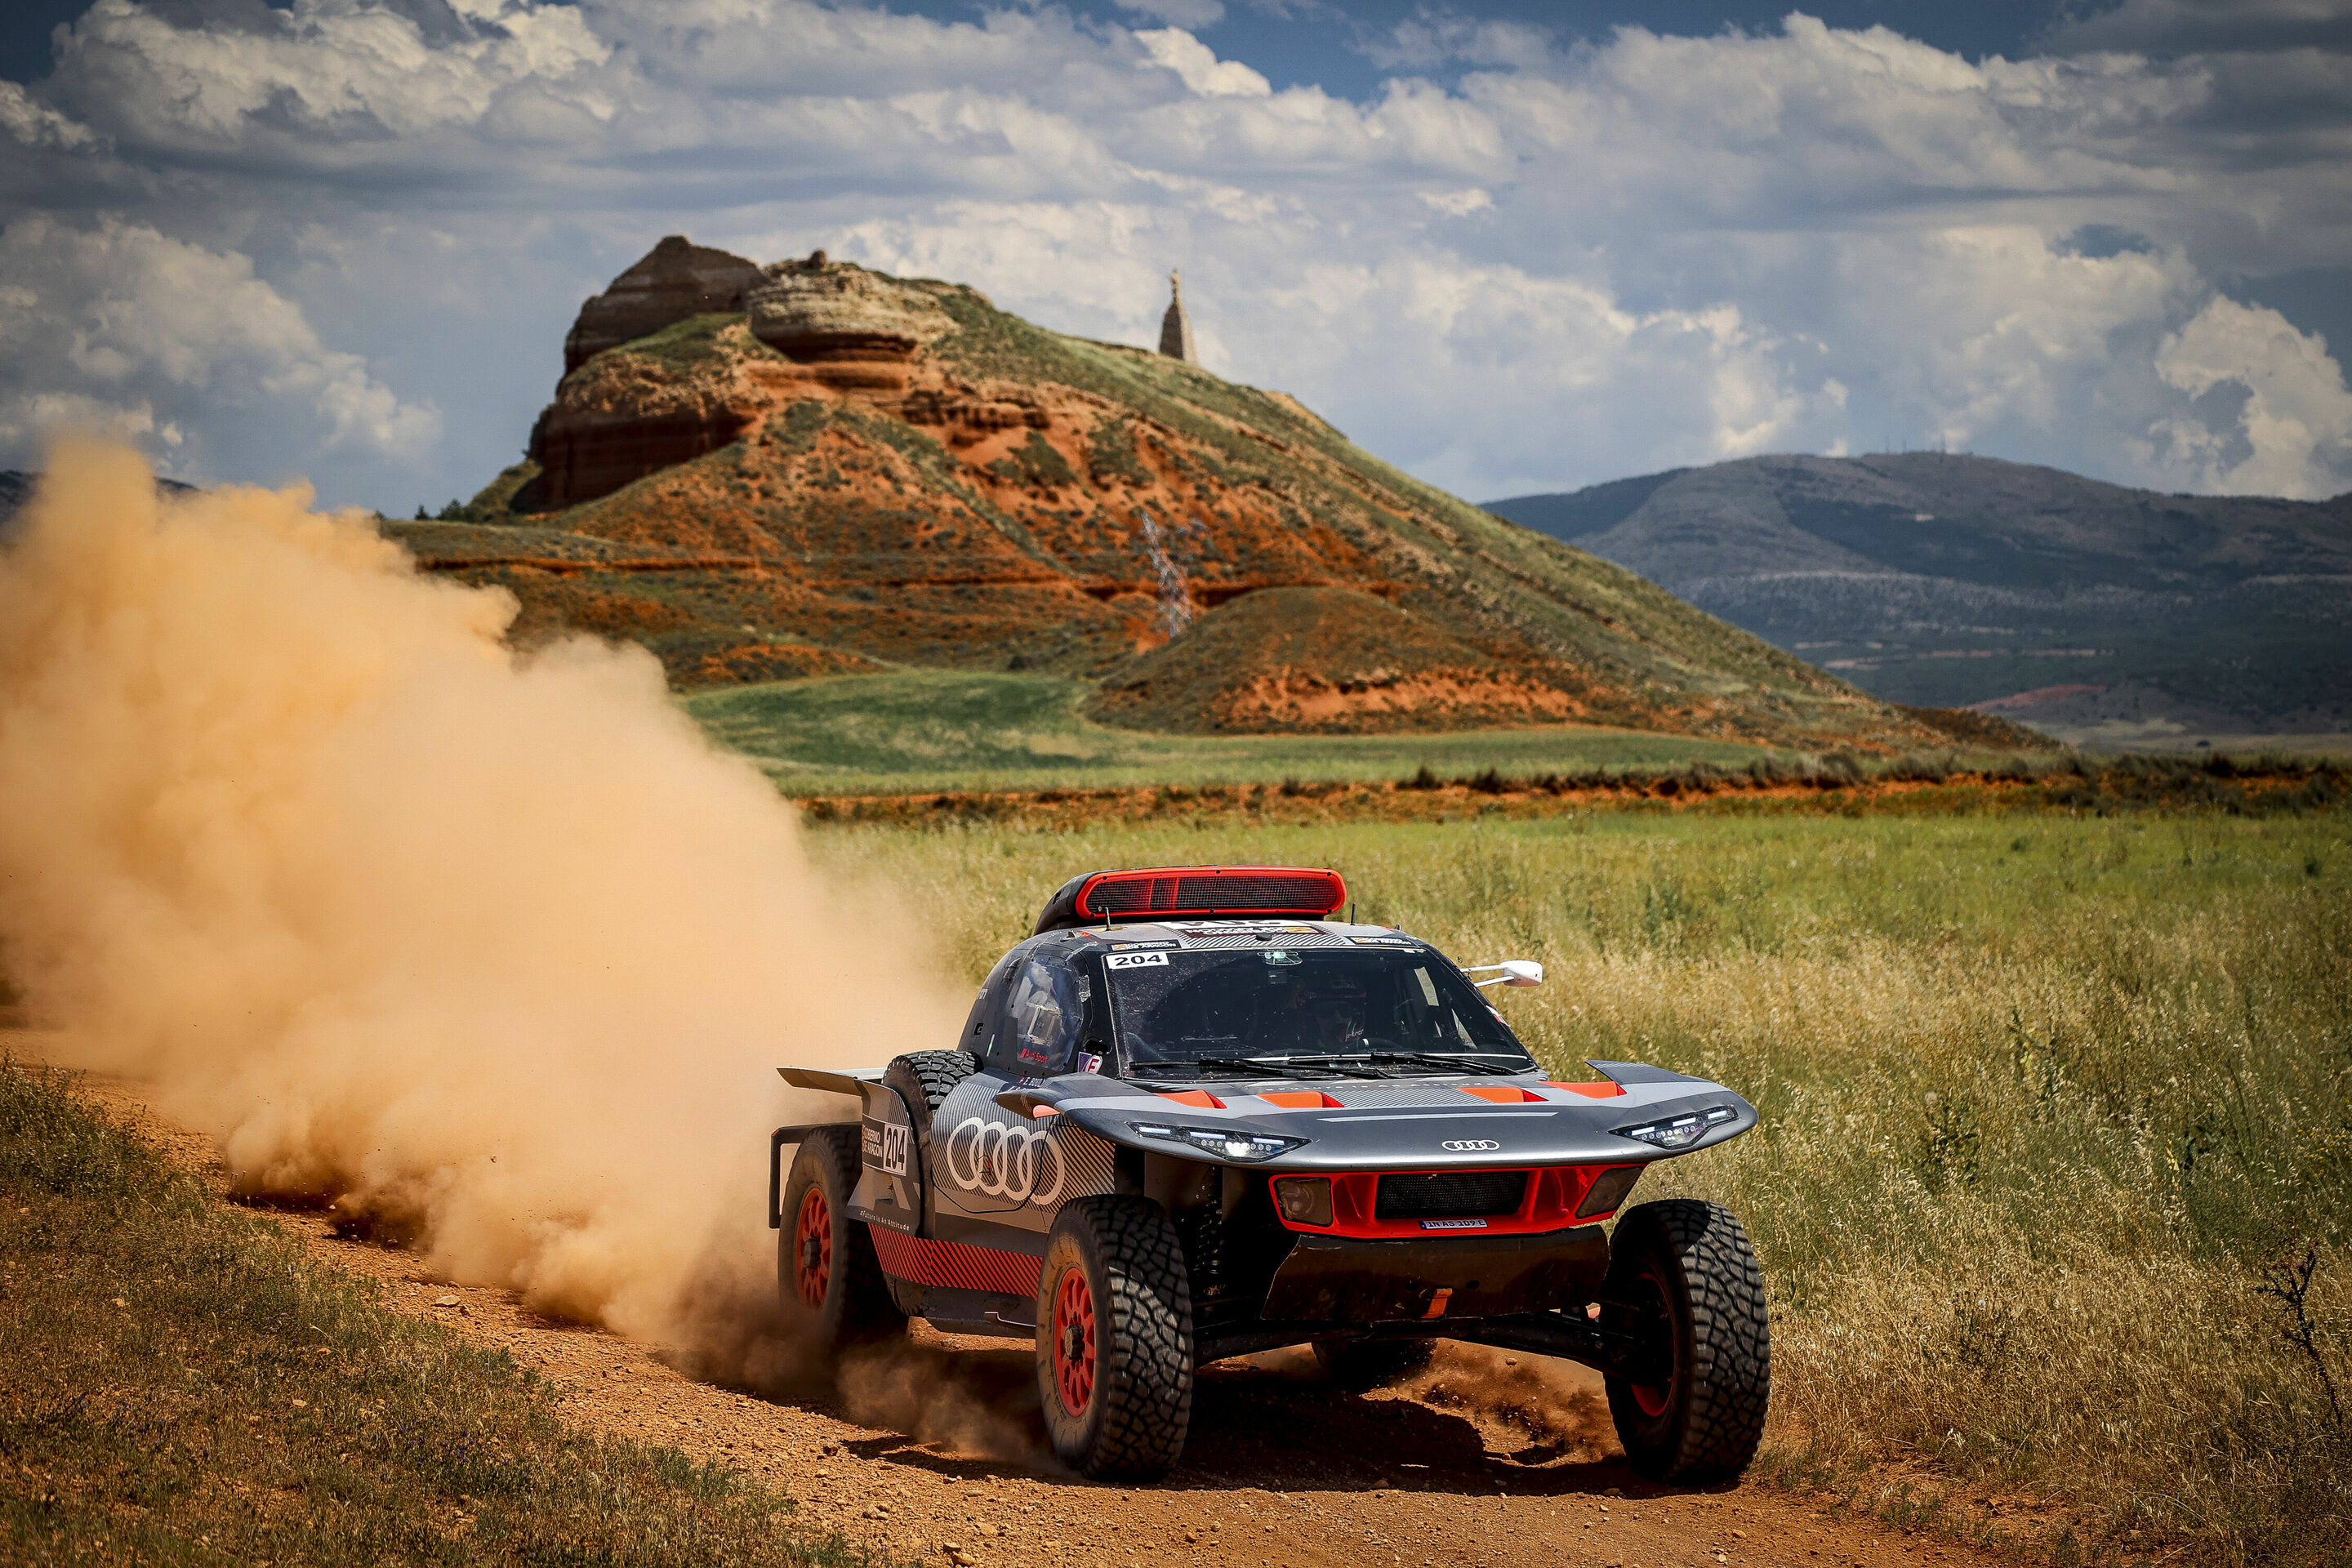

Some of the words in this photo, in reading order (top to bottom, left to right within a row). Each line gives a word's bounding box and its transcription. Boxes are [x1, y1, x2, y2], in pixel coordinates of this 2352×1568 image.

[1115, 955, 1162, 966] 204
[1036, 1052, 1049, 1062] Sport
[1088, 1058, 1099, 1072] E
[885, 1127, 906, 1170] 204
[888, 1219, 910, 1231] Attitude
